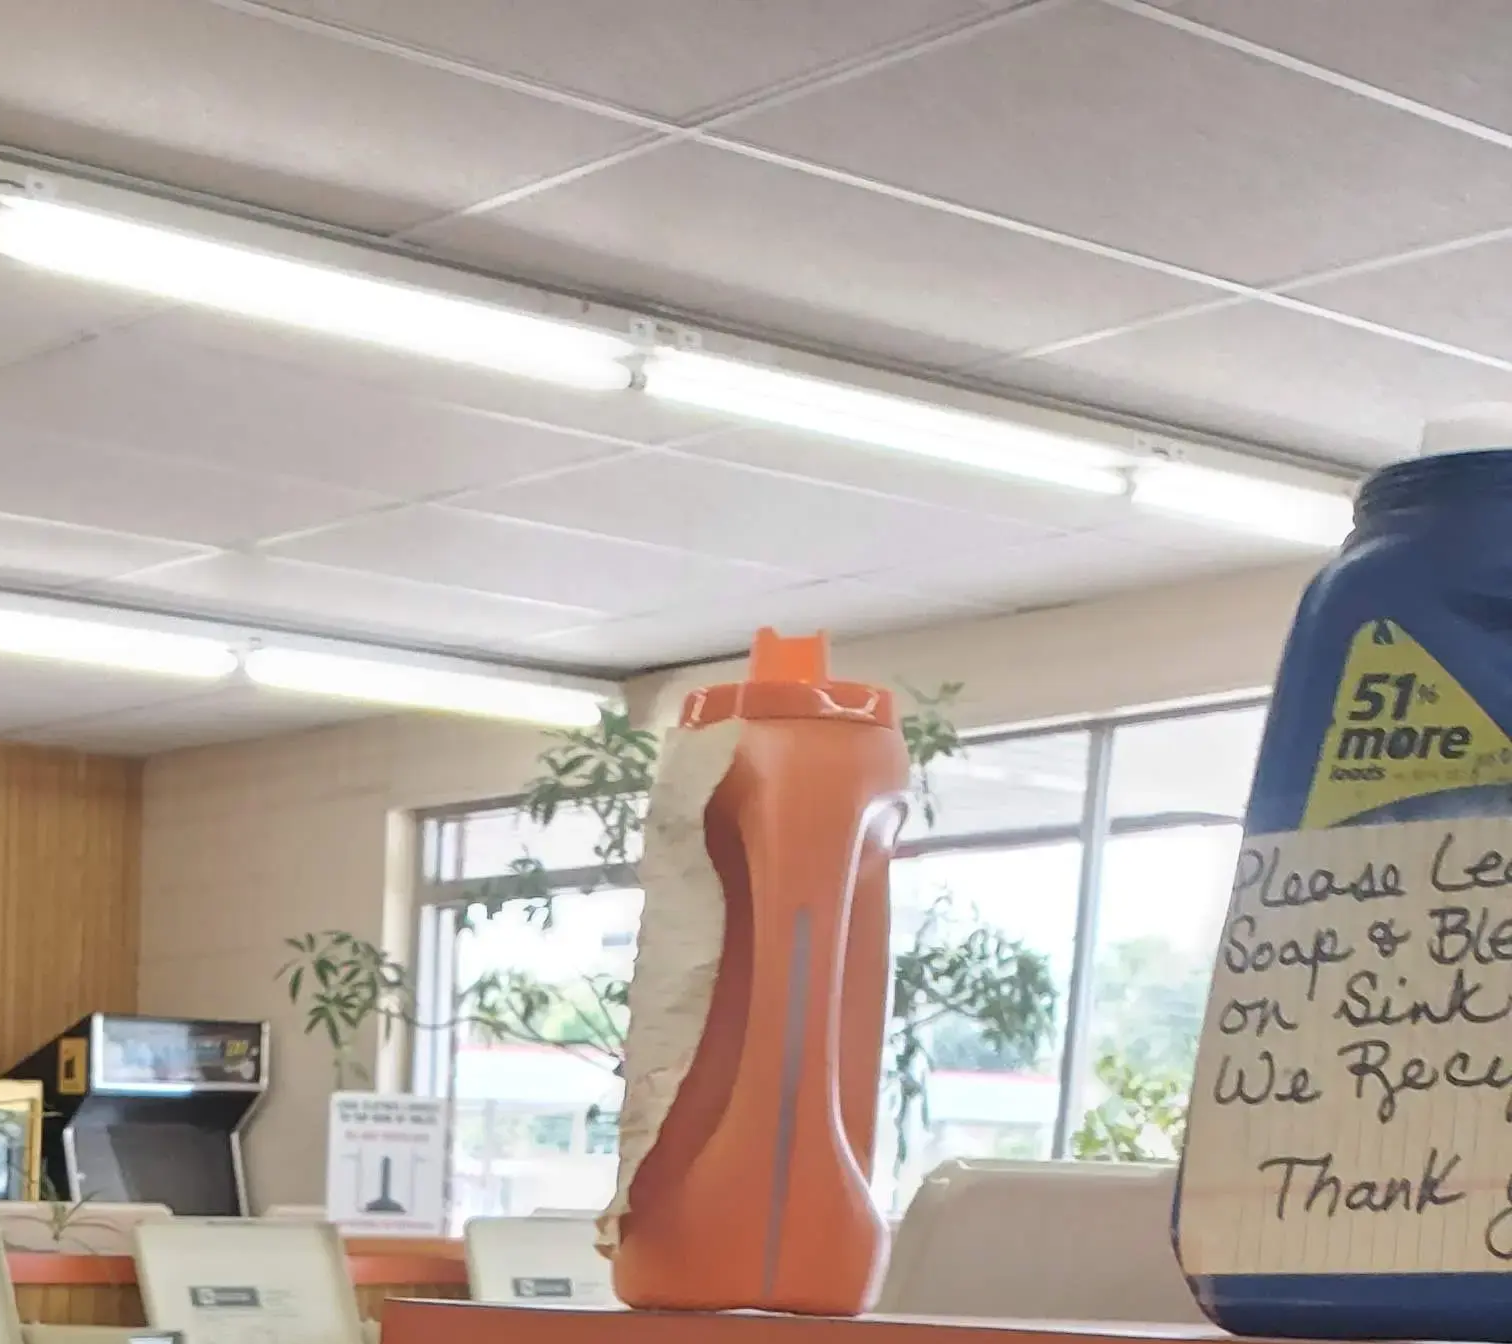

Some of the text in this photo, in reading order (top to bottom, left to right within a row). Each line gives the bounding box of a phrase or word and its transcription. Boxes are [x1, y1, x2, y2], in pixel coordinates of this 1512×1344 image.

[1337, 726, 1472, 760] more
[1232, 846, 1406, 914] Please
[1224, 914, 1356, 1001] Soap
[1219, 969, 1512, 1037] on Sink
[1213, 1050, 1323, 1104] We
[1257, 1147, 1467, 1220] Thank
